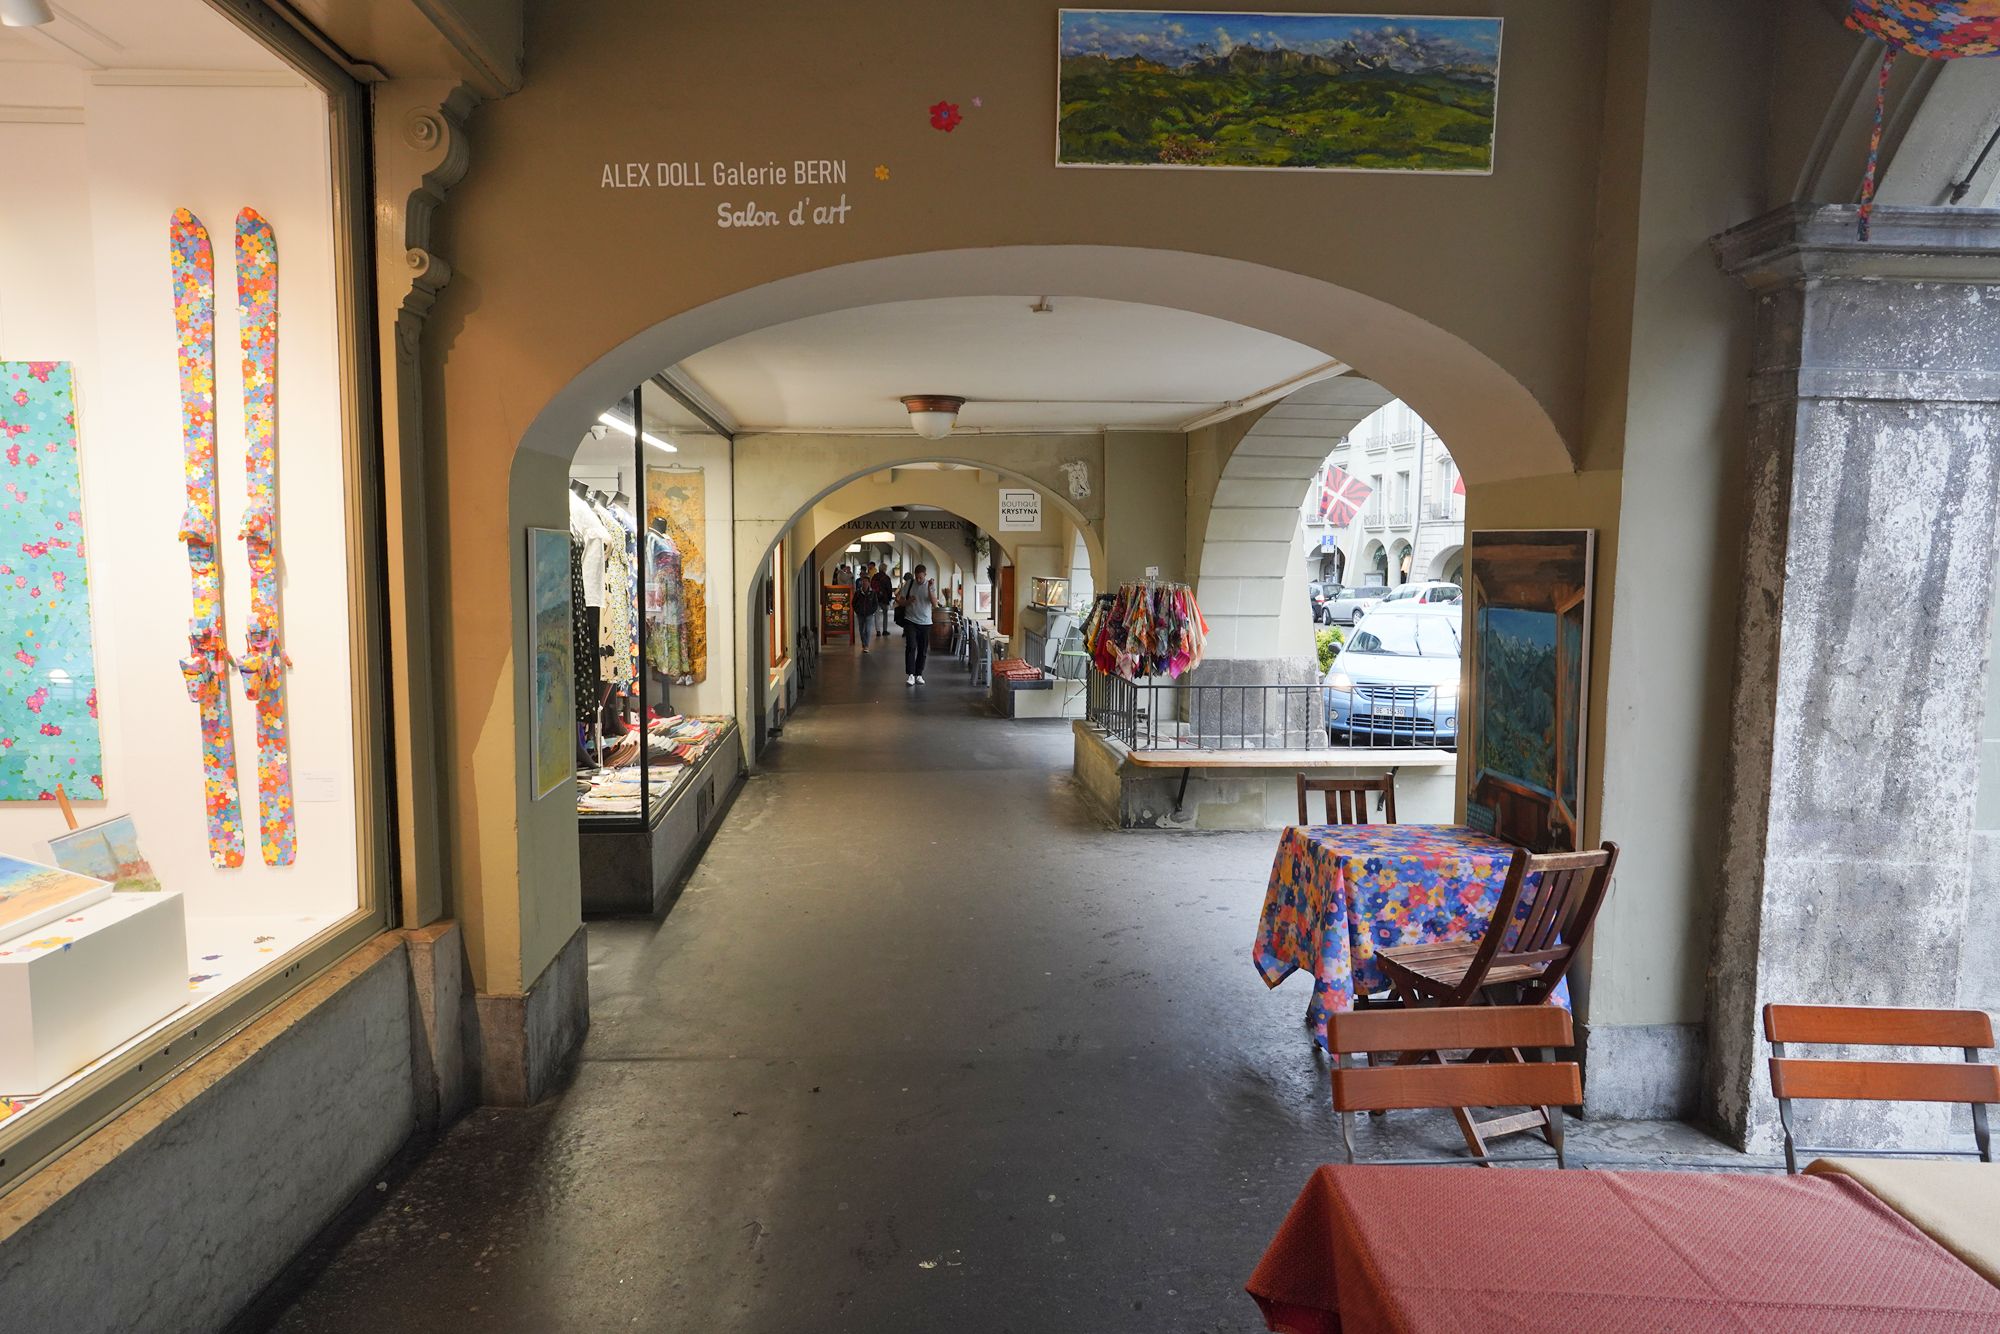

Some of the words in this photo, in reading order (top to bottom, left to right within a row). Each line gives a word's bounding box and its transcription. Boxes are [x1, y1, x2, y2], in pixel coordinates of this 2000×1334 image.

[602, 163, 650, 187] ALEX
[658, 163, 705, 186] DOLL
[714, 162, 786, 185] Galerie
[795, 160, 845, 184] BERN
[718, 202, 779, 227] Salon
[789, 194, 851, 225] d'art
[1001, 500, 1038, 508] BOUTIQUE
[900, 520, 915, 529] ZU
[919, 520, 964, 529] WEBERN
